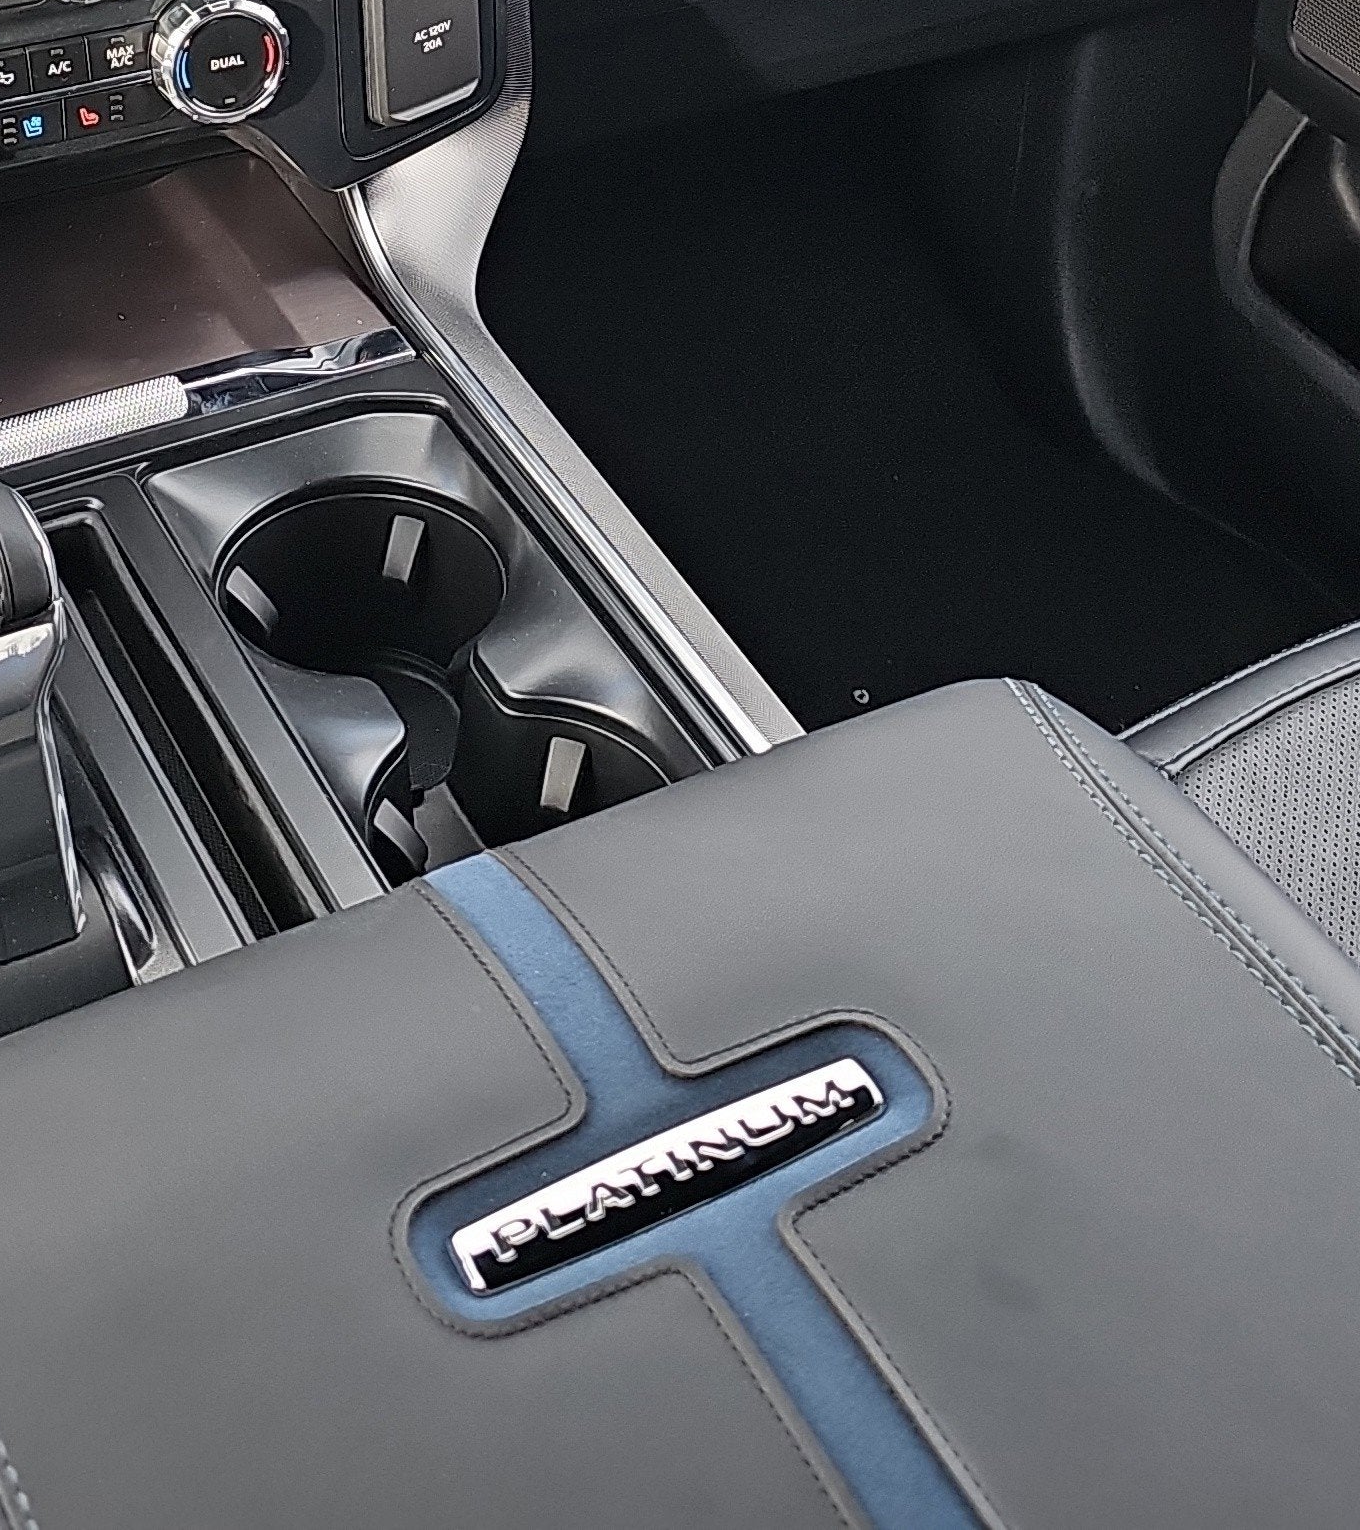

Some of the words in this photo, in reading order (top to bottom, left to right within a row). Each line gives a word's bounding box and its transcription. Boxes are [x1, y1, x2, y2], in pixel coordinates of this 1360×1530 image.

[413, 27, 429, 44] AC
[428, 19, 452, 39] 120V
[106, 43, 135, 60] MAX
[423, 37, 443, 53] 20A
[47, 59, 72, 76] A/C
[110, 54, 134, 69] A/C
[210, 53, 245, 71] DUAL
[490, 1078, 856, 1263] PLATINUM
